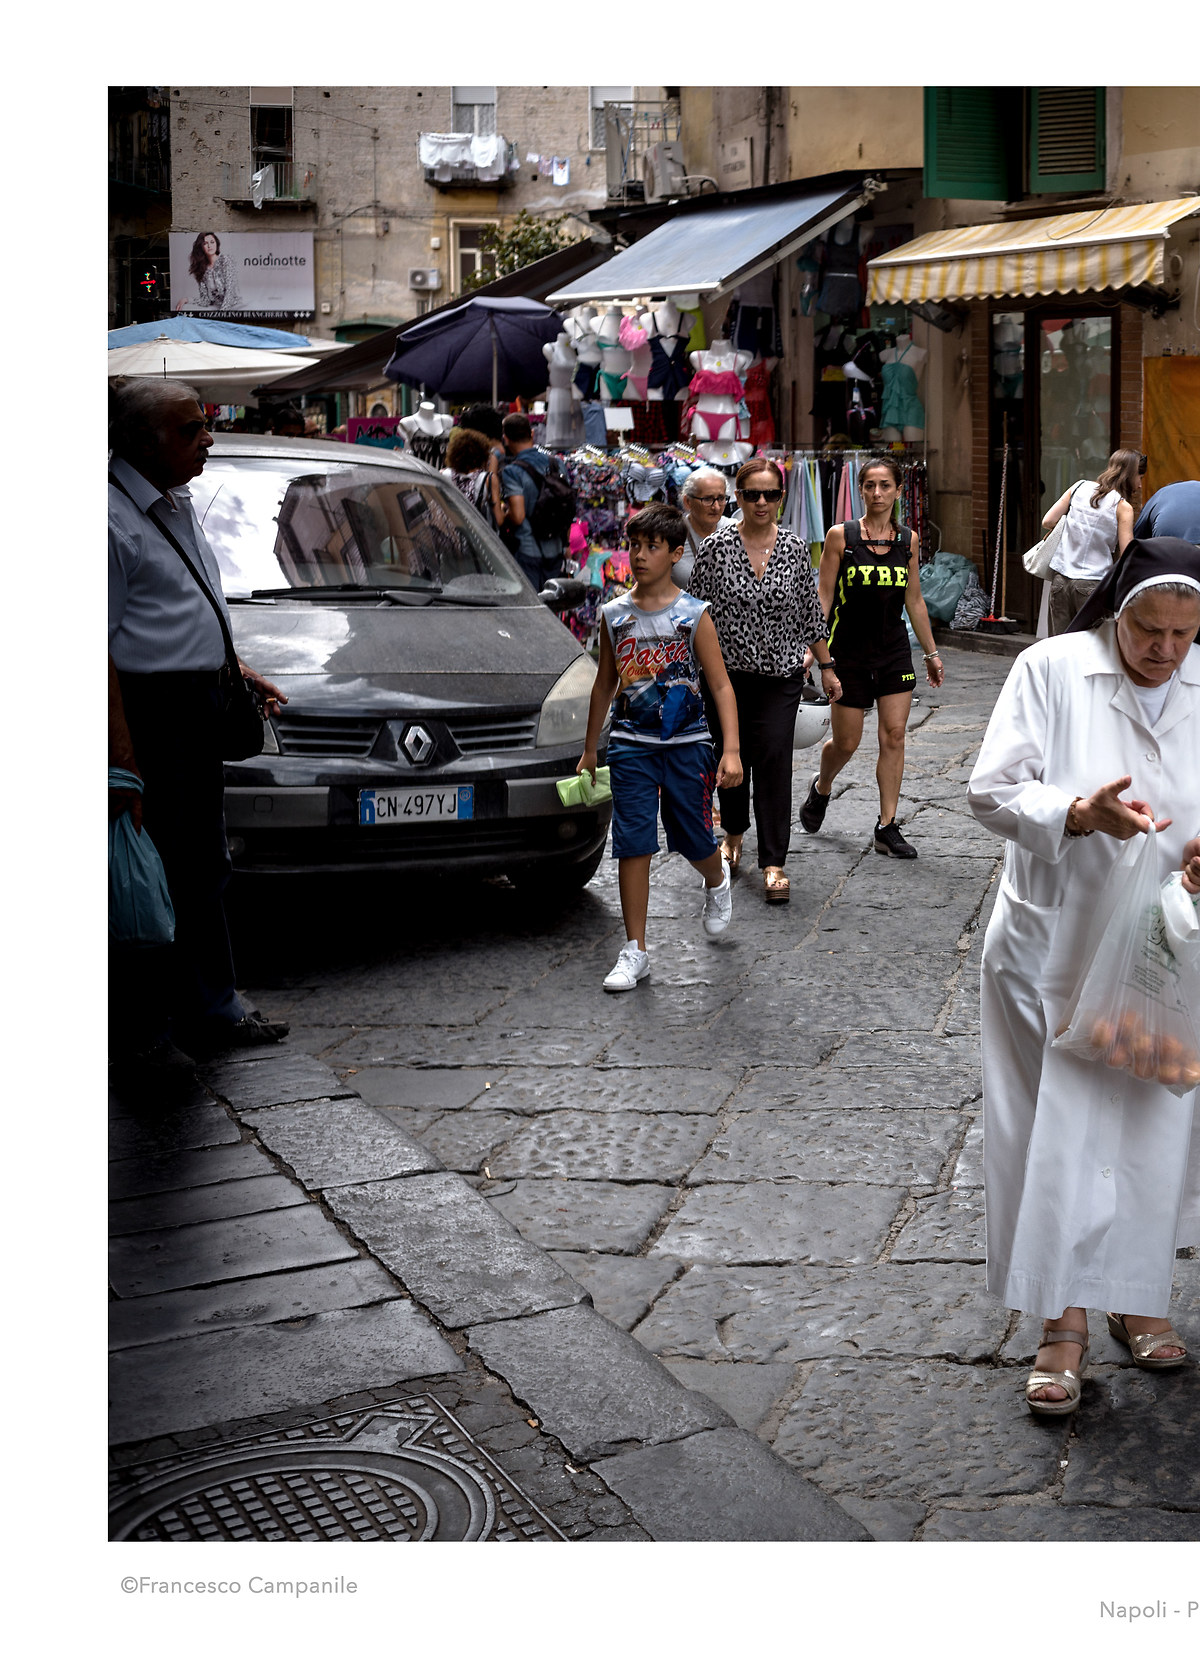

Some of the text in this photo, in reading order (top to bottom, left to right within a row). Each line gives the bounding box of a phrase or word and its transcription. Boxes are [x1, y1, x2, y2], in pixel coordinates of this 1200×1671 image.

[243, 253, 306, 266] noidinotte
[847, 565, 909, 588] PYRE
[616, 637, 689, 675] Faith
